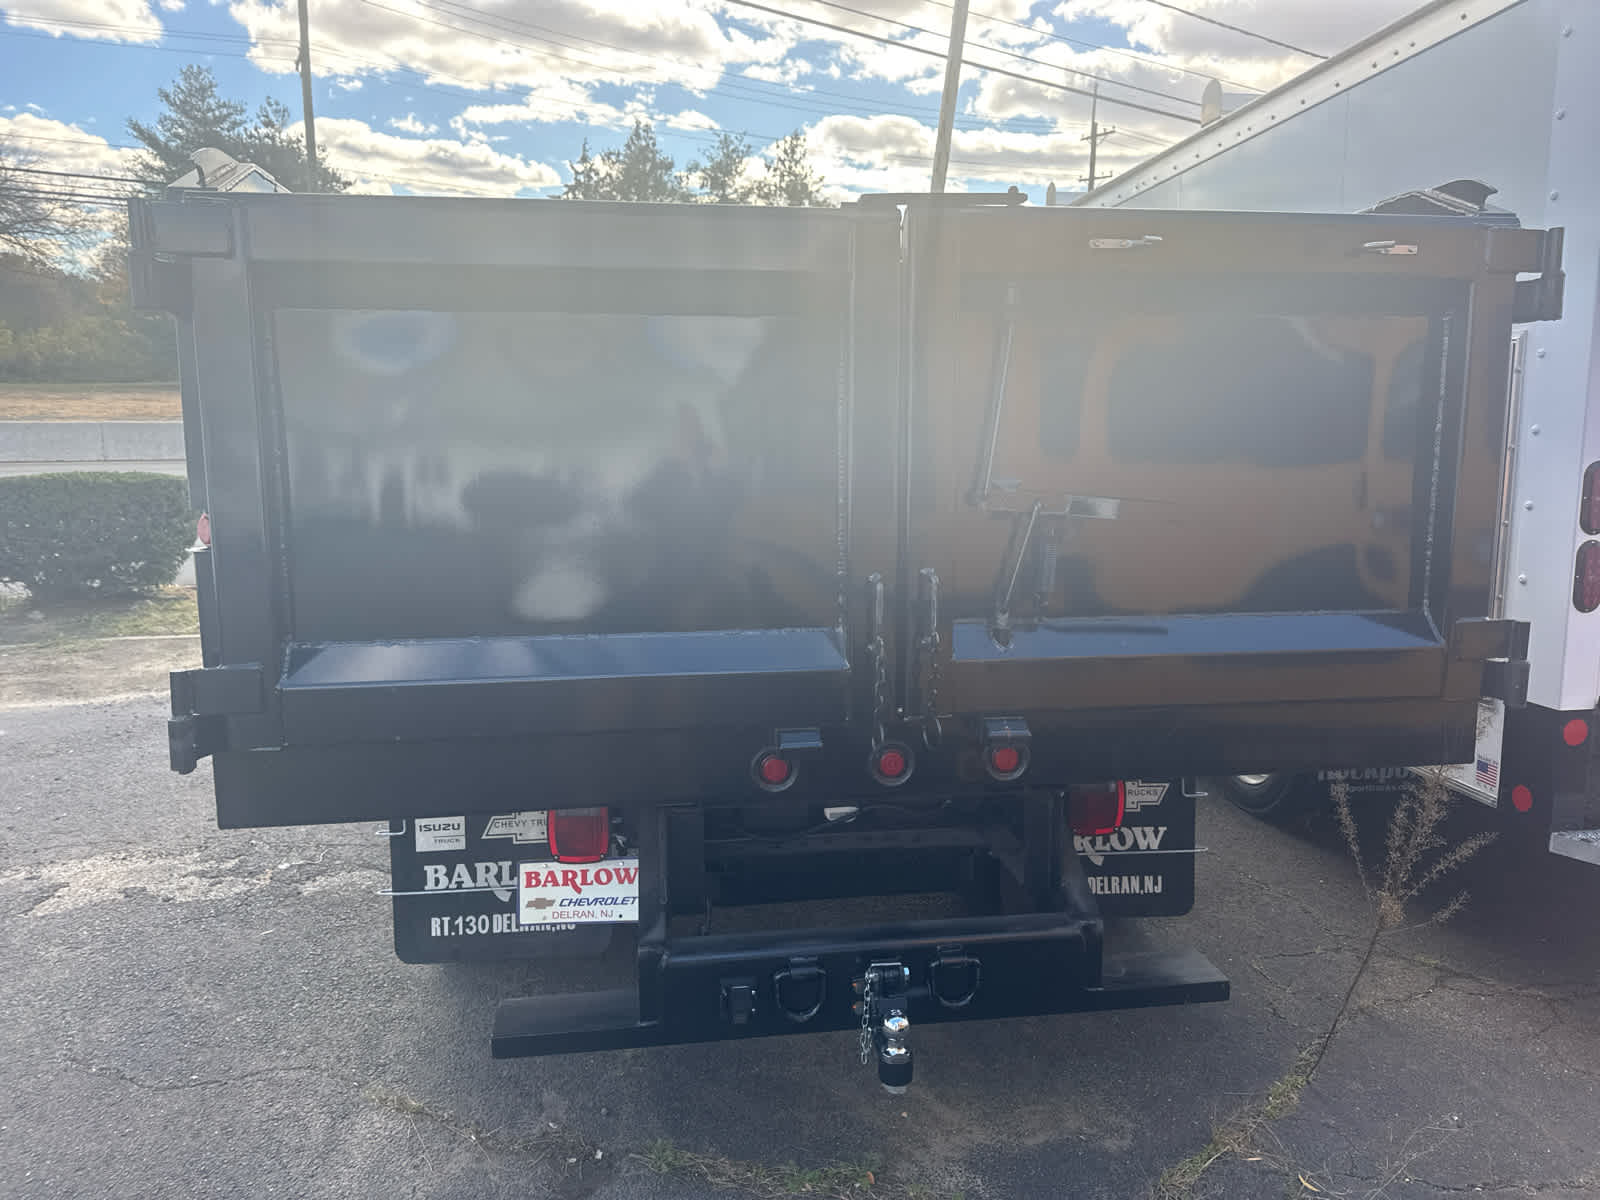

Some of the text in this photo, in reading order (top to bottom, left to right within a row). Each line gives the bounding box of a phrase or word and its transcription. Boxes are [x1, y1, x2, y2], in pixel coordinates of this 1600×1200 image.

[1127, 788, 1159, 797] RUCKS
[418, 822, 461, 832] ISUZU
[494, 819, 528, 829] CHEVY
[1073, 826, 1168, 866] RLOW
[423, 860, 518, 903] BARL
[524, 867, 638, 895] BARLOW
[559, 896, 638, 908] CHEVROLET
[600, 909, 614, 919] NJ
[430, 915, 488, 937] RT.130
